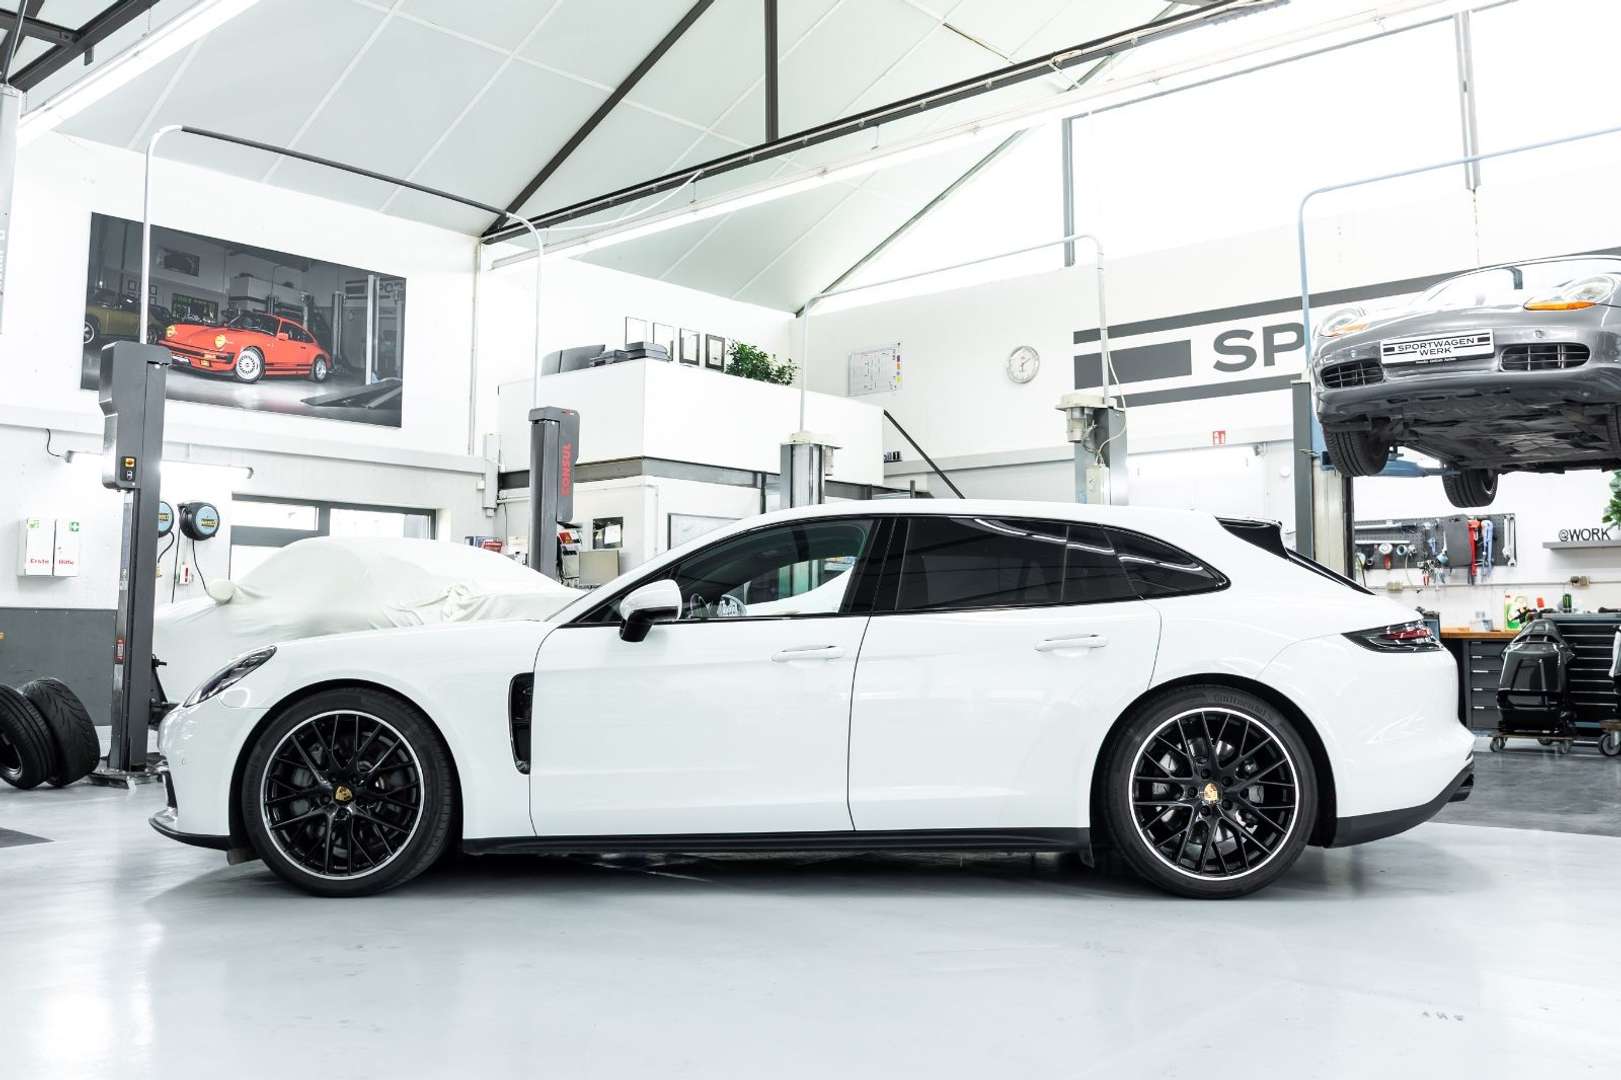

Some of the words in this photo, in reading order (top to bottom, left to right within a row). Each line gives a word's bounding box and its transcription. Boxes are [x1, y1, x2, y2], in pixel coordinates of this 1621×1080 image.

[1398, 337, 1475, 352] SPORTWAGEN
[1419, 347, 1452, 356] WERK
[1559, 527, 1611, 542] @WORK
